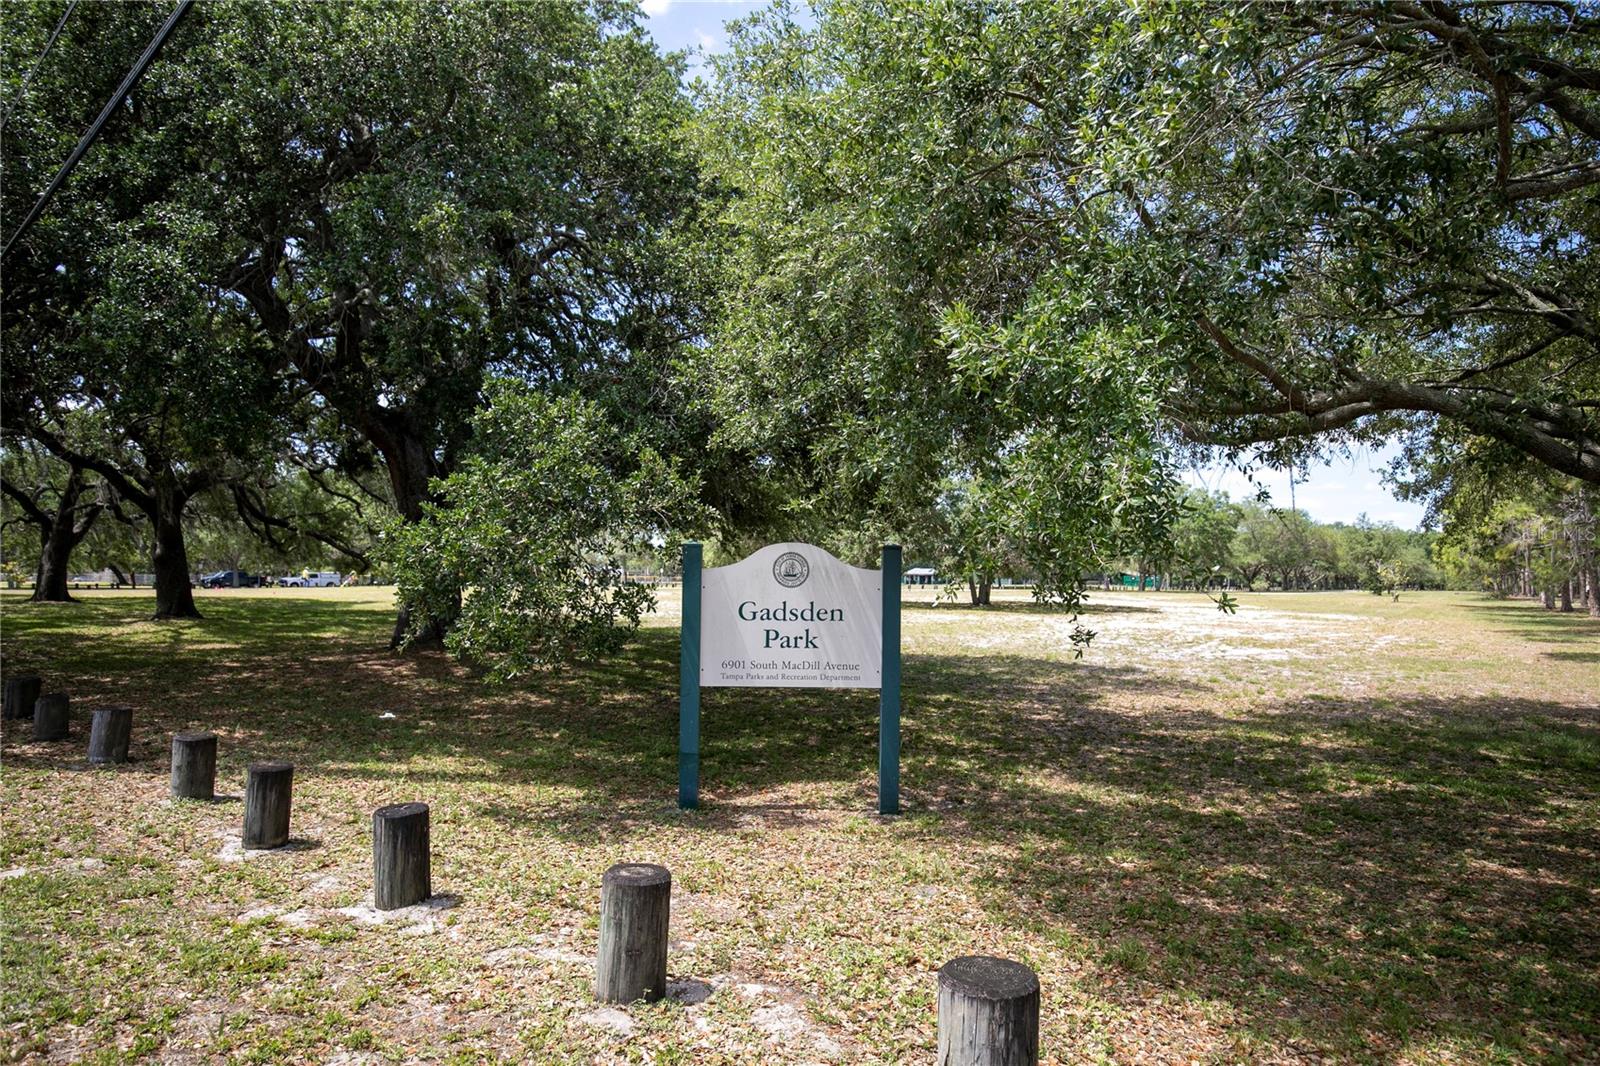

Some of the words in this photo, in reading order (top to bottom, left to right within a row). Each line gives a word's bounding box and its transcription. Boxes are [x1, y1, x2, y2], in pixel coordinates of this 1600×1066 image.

[738, 601, 844, 622] Gadsden
[763, 629, 819, 649] Park
[721, 660, 745, 670] 6901
[750, 660, 778, 670] South
[781, 660, 820, 670] MacDill
[824, 661, 860, 671] Avenue
[720, 672, 744, 681] Tampa
[781, 673, 817, 681] Recreation
[820, 673, 861, 682] Department
